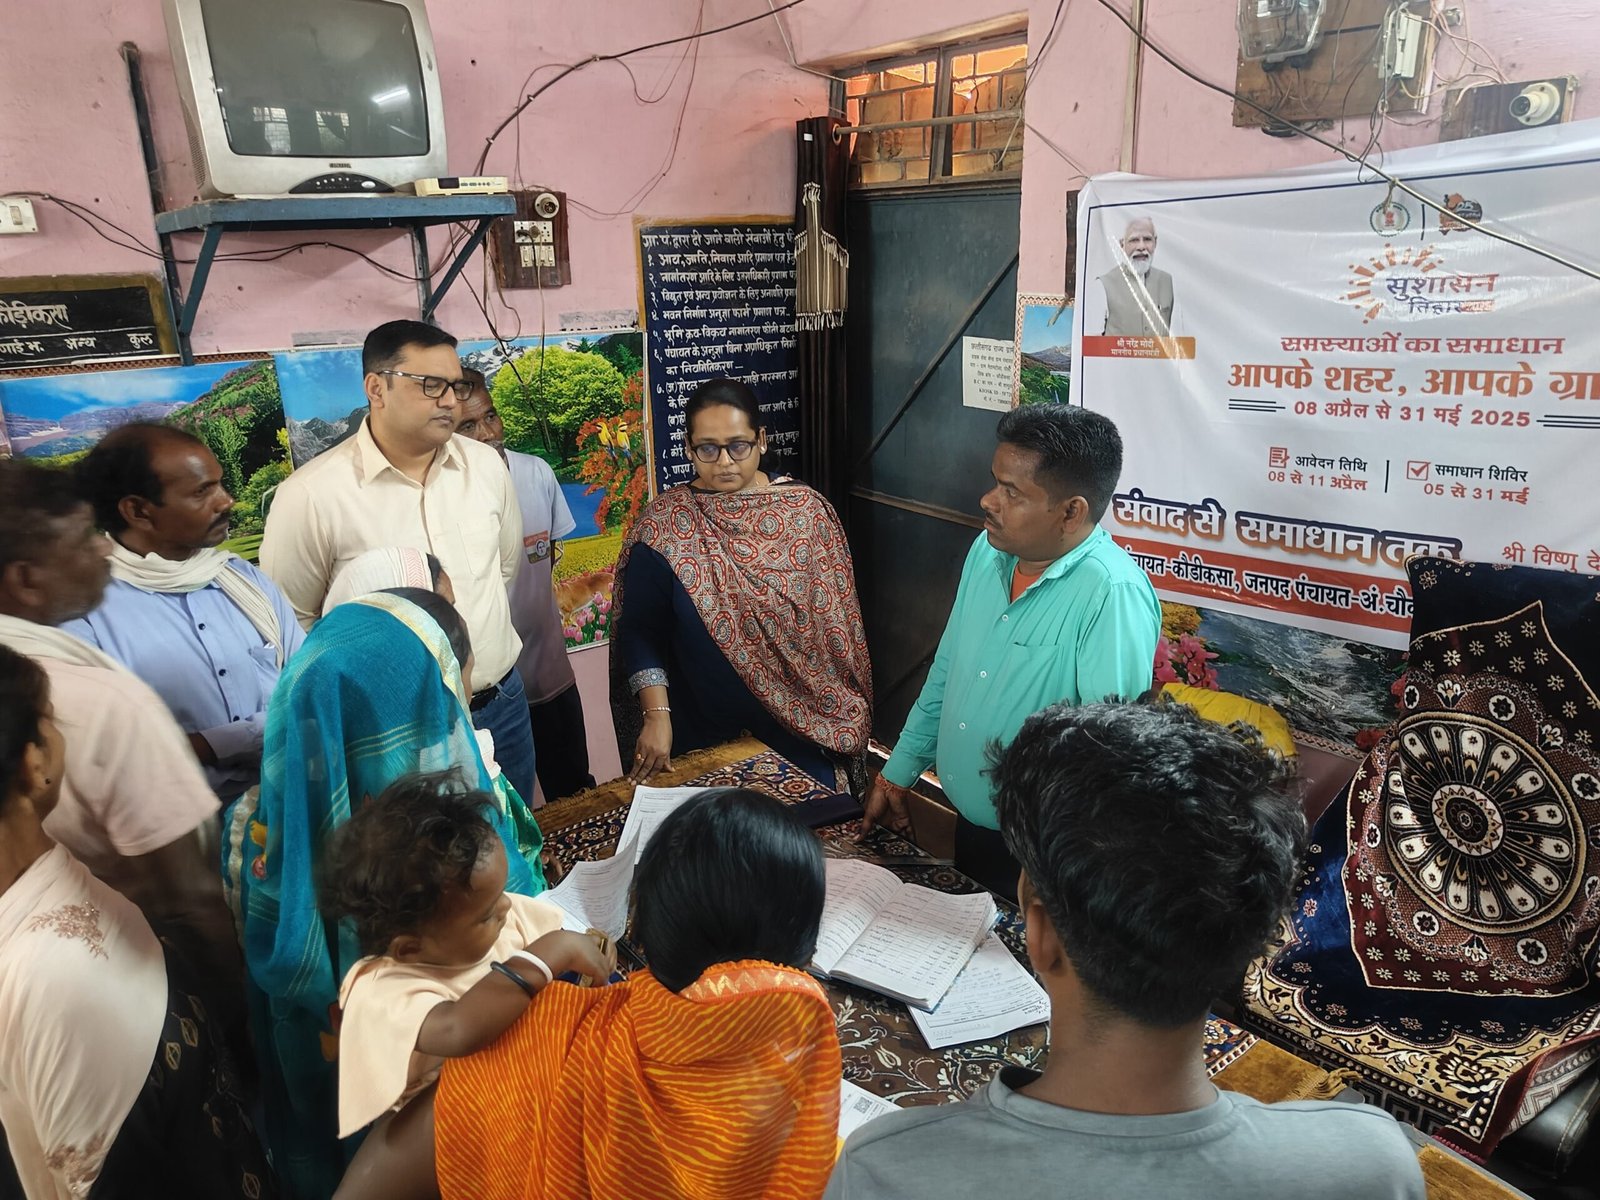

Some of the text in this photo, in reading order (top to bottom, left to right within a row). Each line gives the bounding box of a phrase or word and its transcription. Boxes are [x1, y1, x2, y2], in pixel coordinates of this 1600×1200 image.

[691, 229, 702, 247] दी
[771, 228, 786, 248] हेतु
[737, 249, 754, 266] आदि
[722, 268, 735, 282] लिए
[738, 286, 746, 299] के
[746, 286, 760, 300] लिए
[1386, 274, 1499, 301] सुशासन
[662, 310, 682, 321] भवन
[752, 307, 773, 322] प्रमाण
[64, 337, 96, 350] अन्य
[127, 333, 153, 349] कुल
[664, 345, 692, 359] पंचायत
[691, 341, 700, 356] के
[725, 339, 743, 354] बिना
[1281, 332, 1566, 354] समस्याओं का समाधान
[666, 365, 678, 376] का
[1228, 358, 1314, 389] आपके
[1324, 366, 1407, 397] शहर,
[1420, 361, 1536, 398] आपके
[667, 395, 677, 409] के
[1294, 398, 1531, 427] 08 अप्रैल से 31 मई 2025
[1295, 453, 1367, 472] आवेदन तिथि
[1268, 469, 1368, 491] 08 से 11 अप्रैल
[1435, 464, 1528, 482] समाधान शिविर
[1424, 482, 1530, 505] 05 से 31 मई
[1113, 489, 1189, 535] संवाद
[1193, 500, 1225, 538] से
[1237, 513, 1378, 563] समाधान
[1502, 541, 1526, 563] श्री
[1532, 544, 1579, 574] विष्णु
[1245, 572, 1291, 598] जनपद
